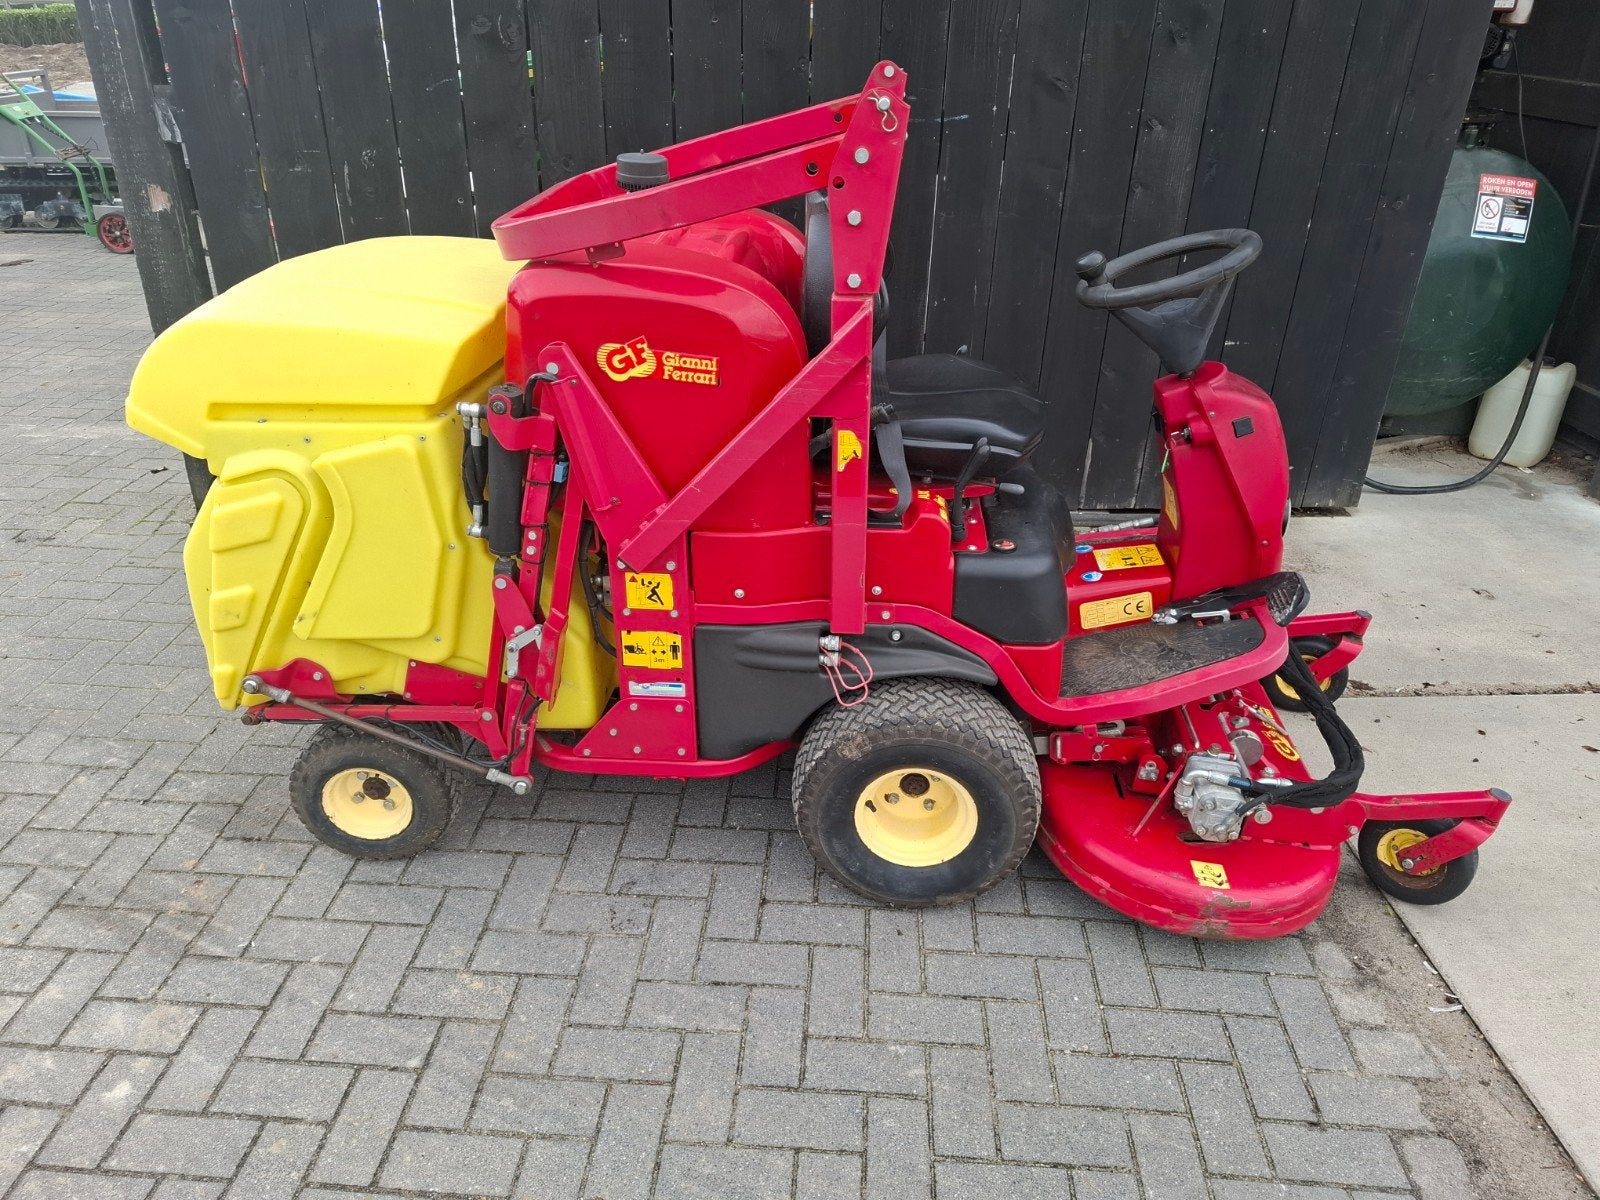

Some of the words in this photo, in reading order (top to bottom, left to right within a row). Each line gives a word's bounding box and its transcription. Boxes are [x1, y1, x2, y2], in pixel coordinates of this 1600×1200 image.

[1482, 177, 1505, 185] ROKEN
[1501, 187, 1533, 195] VERBODEN
[603, 336, 650, 377] GF
[661, 351, 717, 371] Gianni
[663, 366, 717, 385] Ferrari
[1123, 600, 1145, 615] CE
